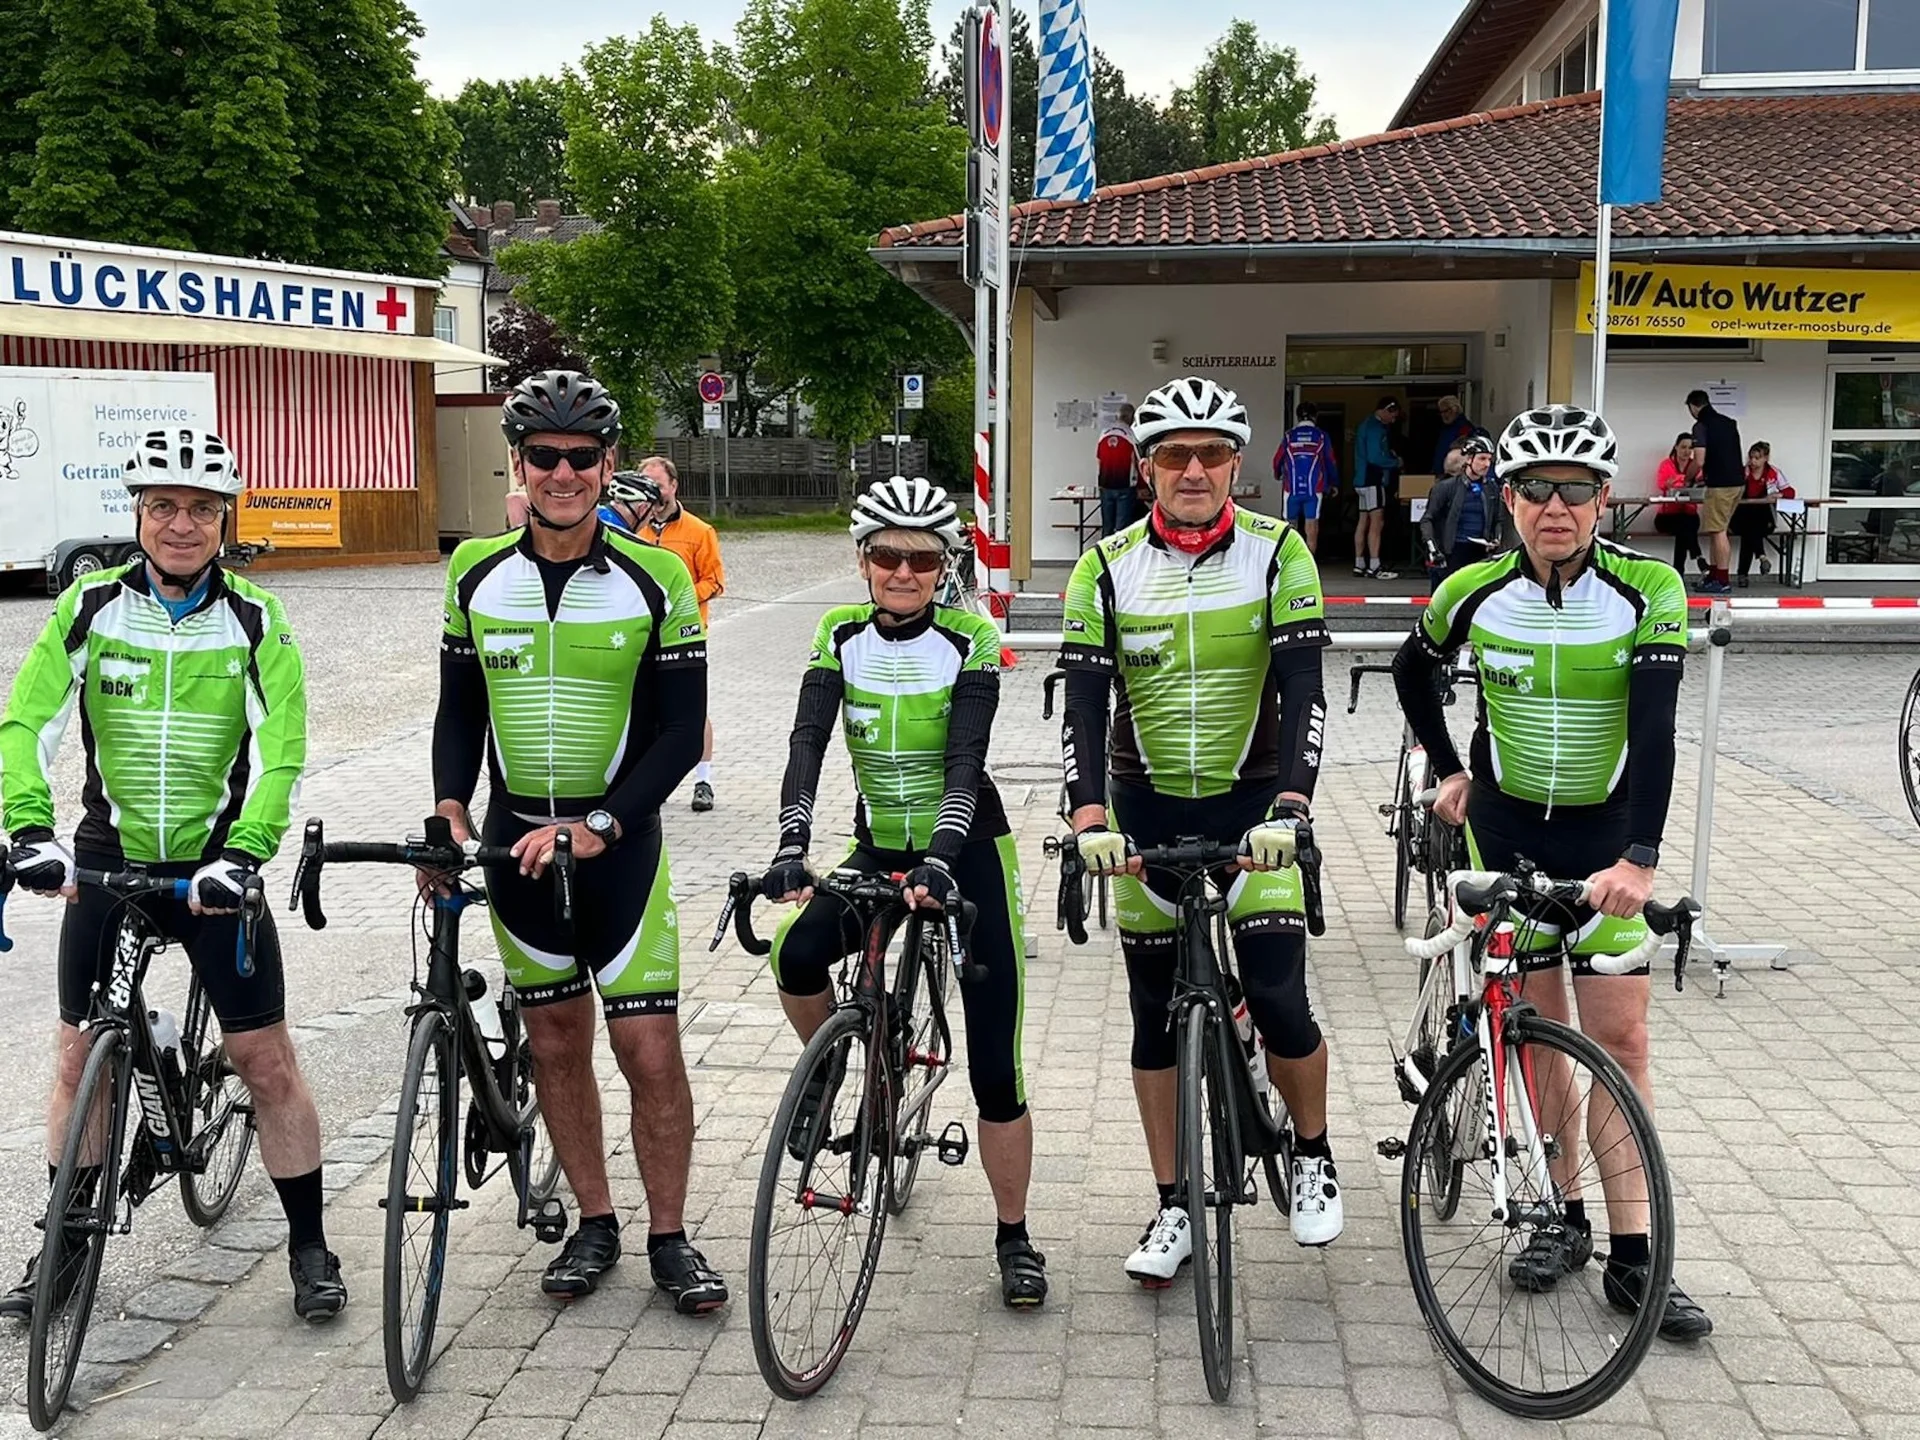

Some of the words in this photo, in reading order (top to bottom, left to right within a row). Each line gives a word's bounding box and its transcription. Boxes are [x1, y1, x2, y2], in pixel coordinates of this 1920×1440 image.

[12, 251, 364, 328] LÜCKSHAFEN
[1652, 278, 1734, 310] Auto
[1742, 281, 1865, 313] Wutzer
[1645, 315, 1686, 328] 76550
[1711, 318, 1893, 336] opel-wutzer-moosburg.de
[1182, 354, 1276, 368] SCHÄFFLERHALLE
[95, 404, 188, 421] Heimservice
[245, 496, 332, 510] JUNGHEINRICH
[485, 655, 519, 669] ROCK
[1124, 653, 1160, 667] ROCK
[1660, 654, 1679, 662] DAV
[1484, 668, 1517, 688] ROCK
[1307, 703, 1326, 750] DAV
[1063, 742, 1080, 784] DAV
[534, 990, 554, 999] DAV
[626, 1000, 647, 1009] DAV
[134, 1066, 170, 1138] GIANT
